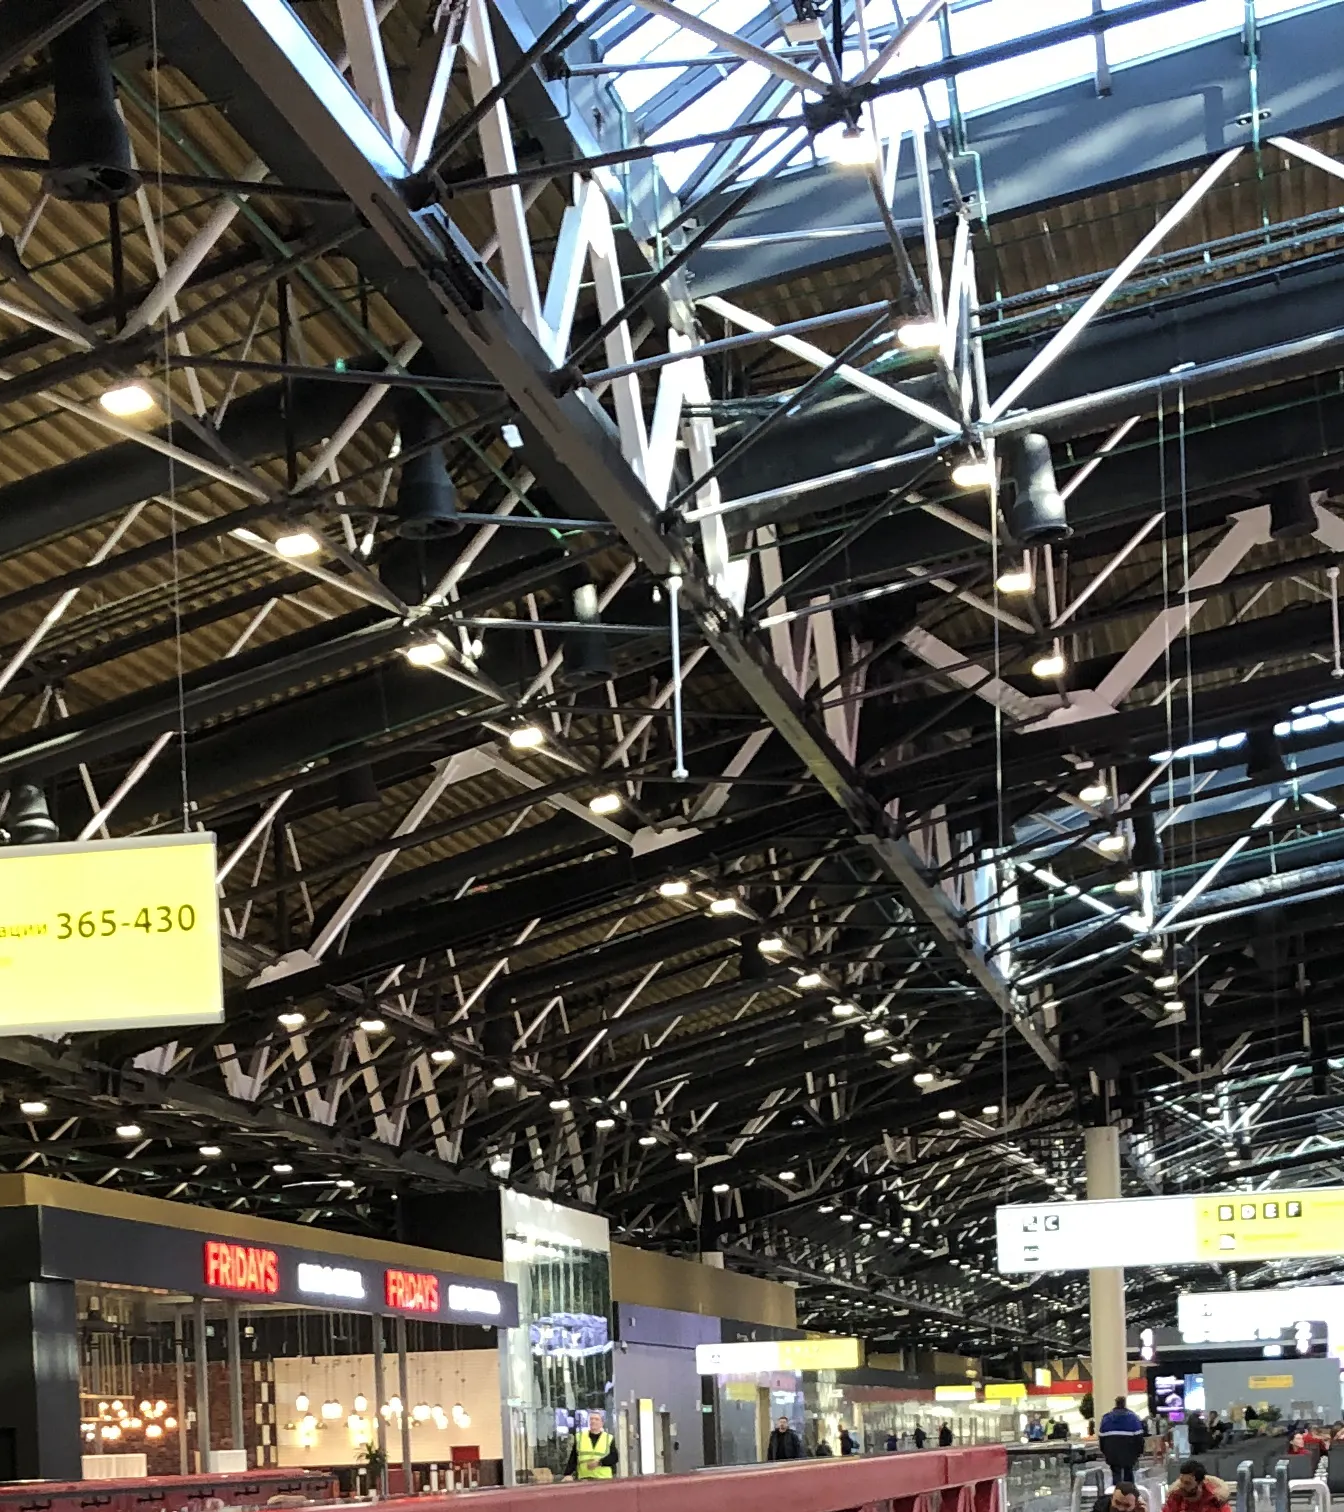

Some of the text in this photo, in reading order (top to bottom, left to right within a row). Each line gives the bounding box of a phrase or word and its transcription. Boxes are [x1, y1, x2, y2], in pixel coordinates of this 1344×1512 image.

[56, 904, 196, 940] 365-430
[205, 1240, 279, 1295] FRIDAYS
[385, 1268, 439, 1313] FRIDAYS
